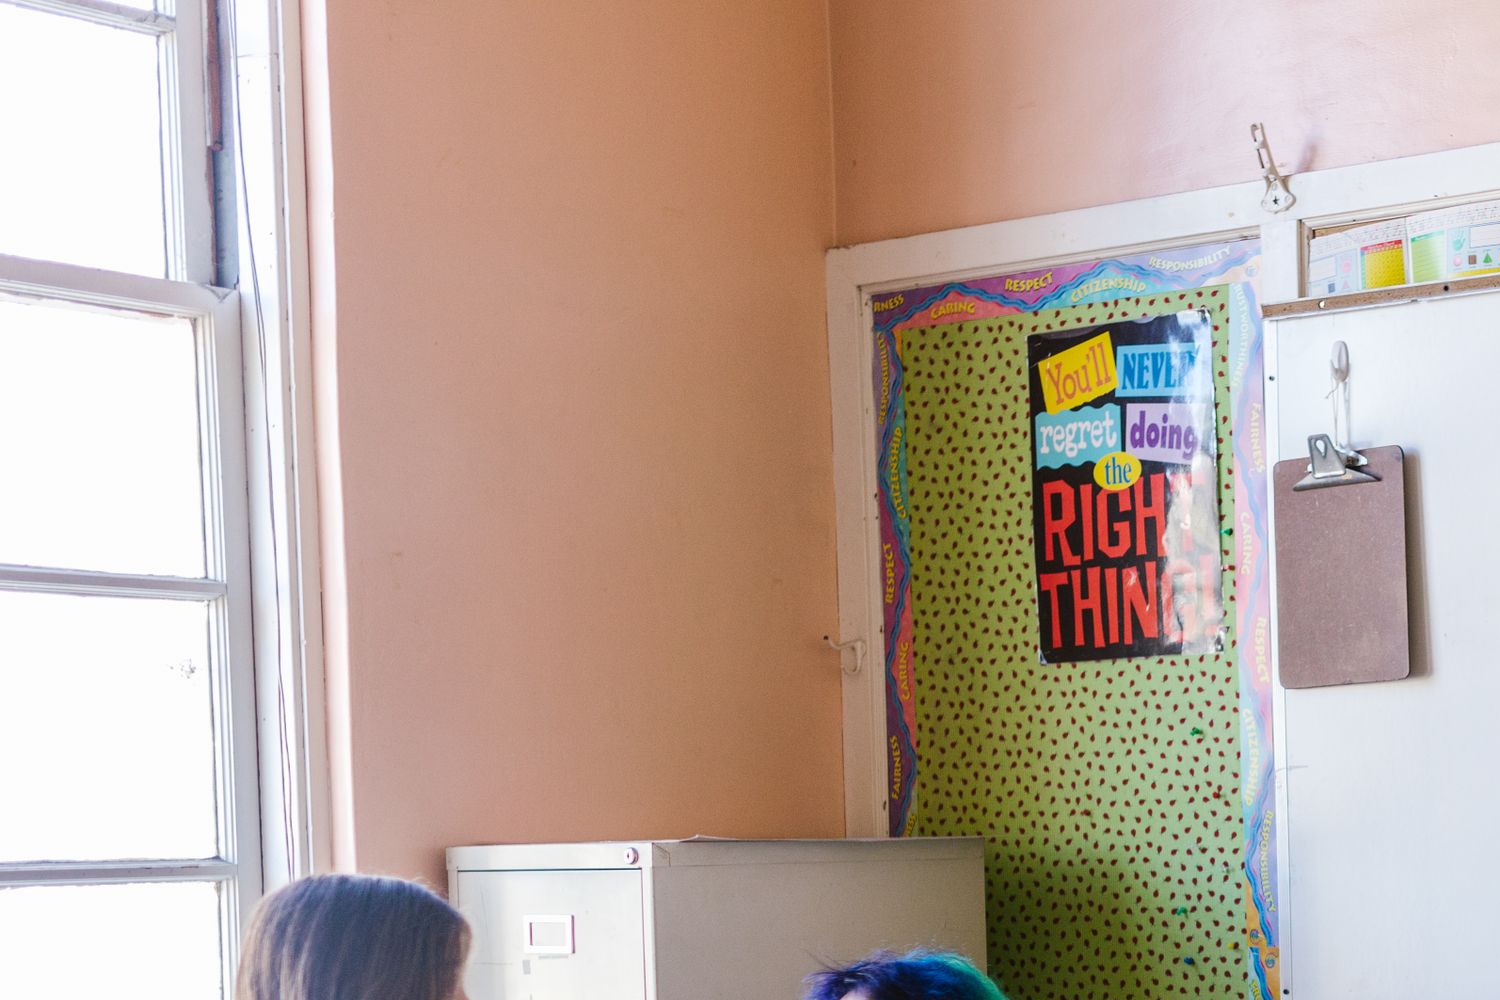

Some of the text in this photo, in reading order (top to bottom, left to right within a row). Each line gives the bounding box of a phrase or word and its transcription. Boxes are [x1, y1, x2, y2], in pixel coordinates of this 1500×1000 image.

[930, 274, 1147, 320] CARING CITIZENSHIP
[1004, 271, 1054, 293] RESPECT
[1147, 243, 1233, 274] RESPONSIBILITY
[1045, 340, 1113, 406] You'll
[1039, 409, 1198, 462] regret doing
[1249, 402, 1266, 474] FAIRNESS
[888, 426, 907, 520] CITIZENSHIP
[1104, 458, 1133, 486] the
[882, 542, 894, 605] RESPECT
[1240, 511, 1252, 576] CARING
[901, 641, 911, 700] CARING
[1254, 616, 1270, 684] RESPECT
[890, 735, 901, 802] FAIRNESS
[1242, 707, 1260, 808] CITIZENSHIP
[1259, 809, 1277, 914] RESPONSIBILITY
